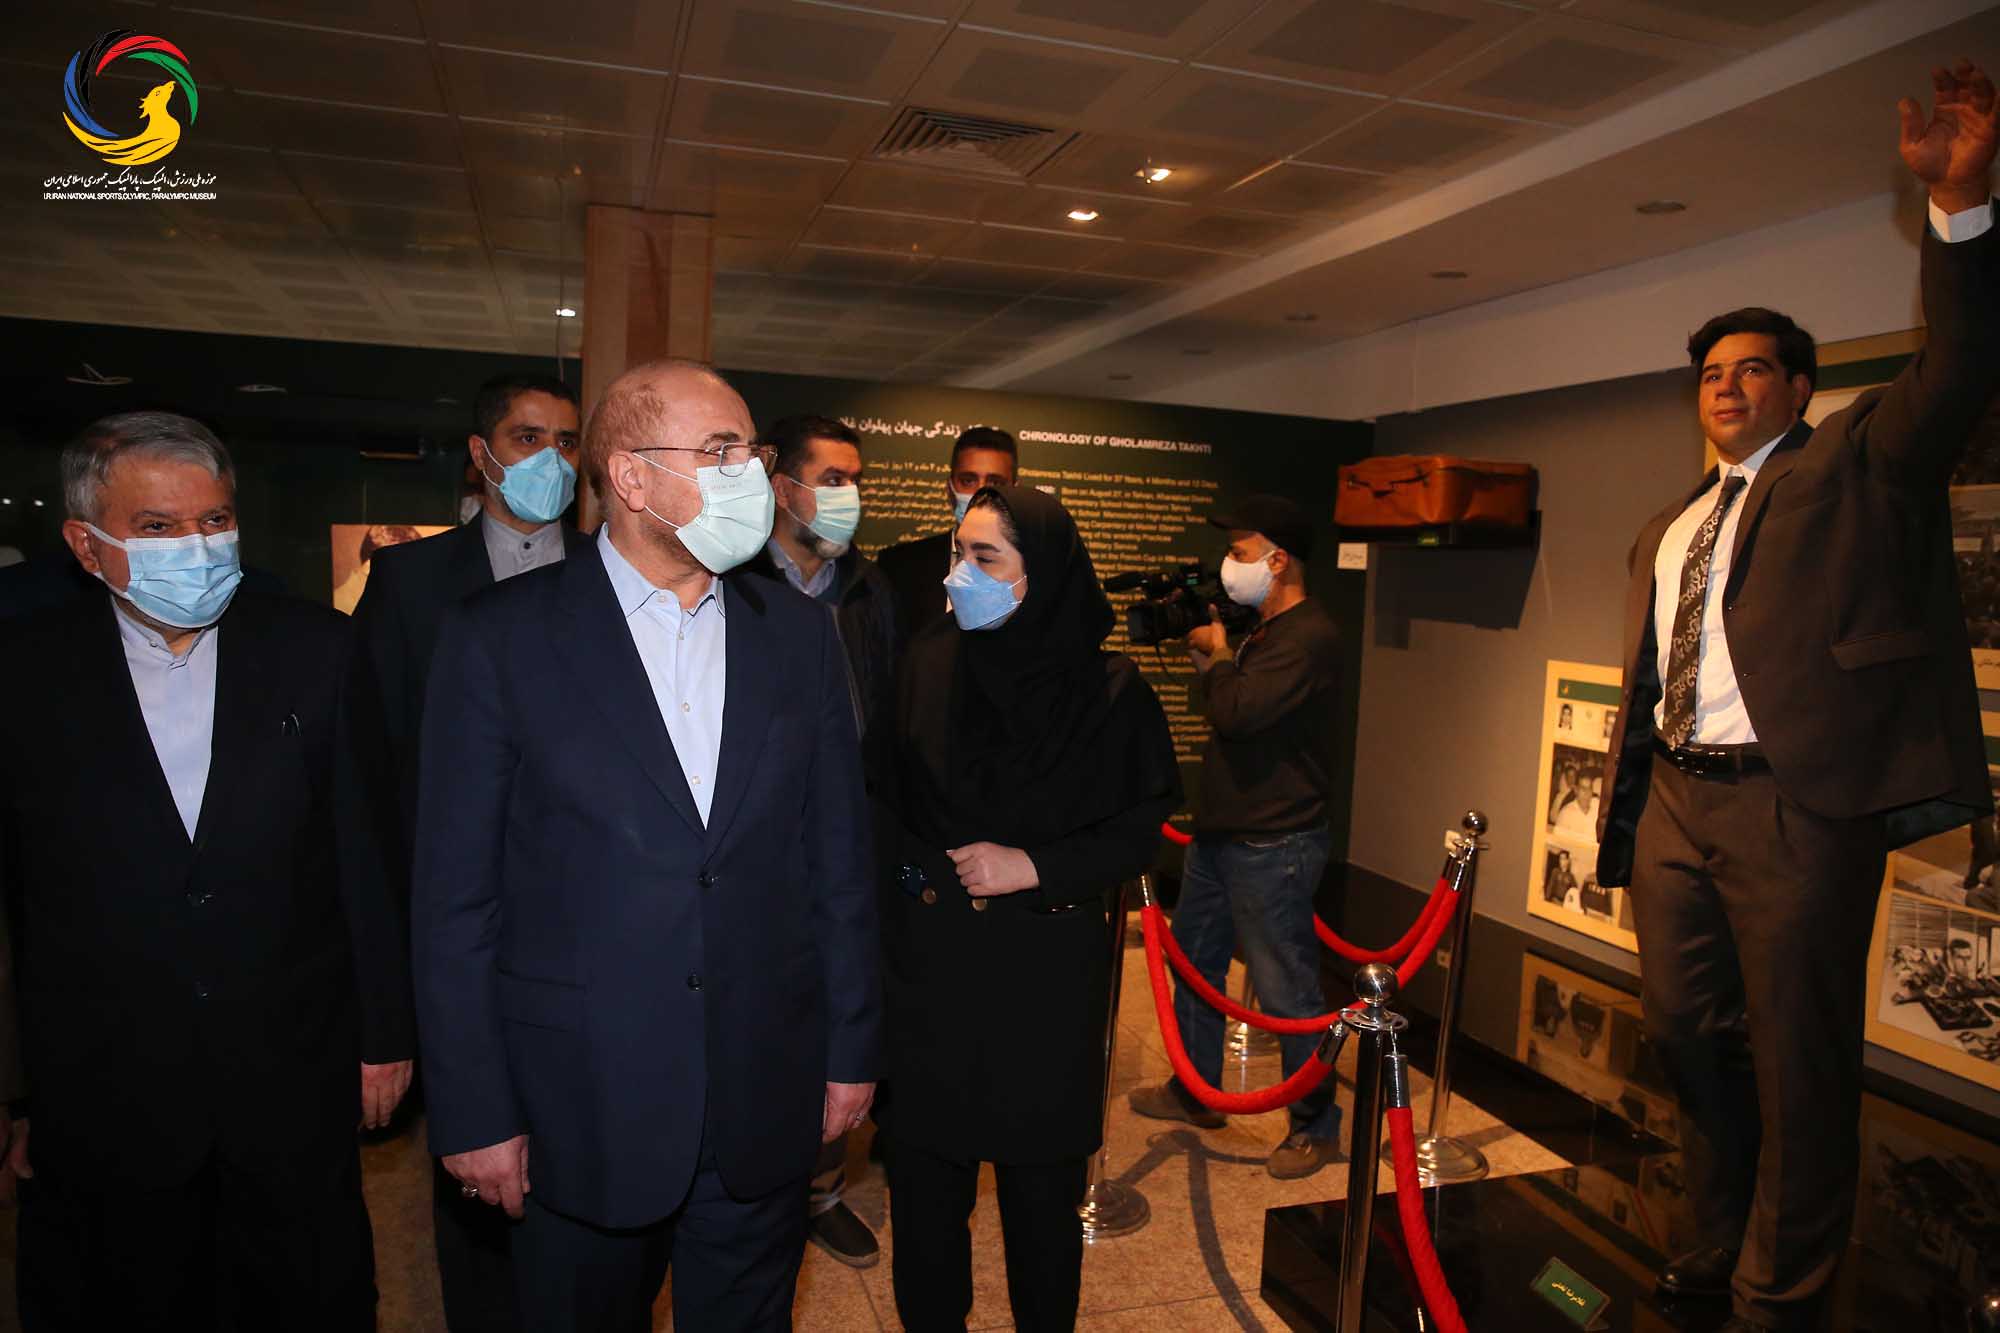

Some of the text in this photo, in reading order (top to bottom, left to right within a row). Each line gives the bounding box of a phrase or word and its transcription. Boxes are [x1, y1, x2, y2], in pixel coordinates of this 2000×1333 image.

[858, 418, 892, 436] پهلوان
[894, 420, 923, 437] جهان
[925, 420, 961, 439] زندگی
[1019, 430, 1212, 454] CHRONOLOGY OF GHOLAMREZA TAKHTI
